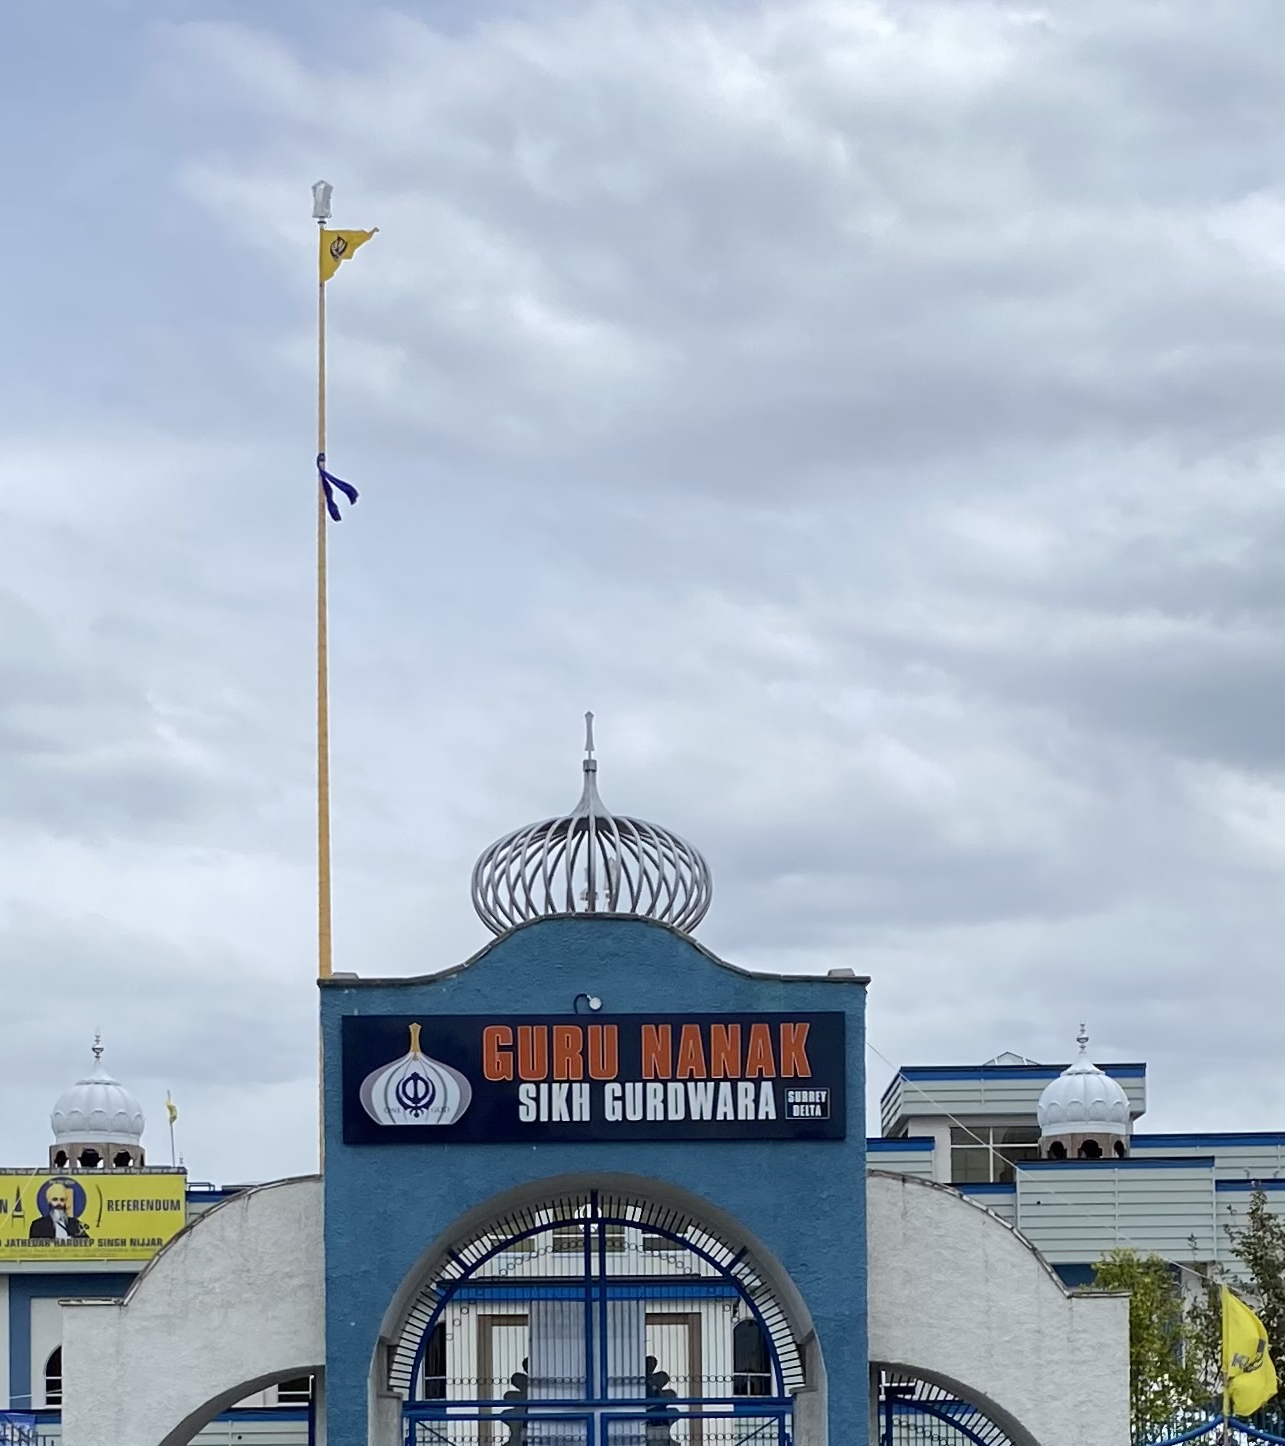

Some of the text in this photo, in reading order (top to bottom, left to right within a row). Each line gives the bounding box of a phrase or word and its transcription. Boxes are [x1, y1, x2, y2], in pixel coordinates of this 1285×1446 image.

[483, 1023, 812, 1081] GURU NANAK
[518, 1081, 777, 1122] SIKH GURDWARA
[788, 1090, 827, 1103] SURREY
[793, 1104, 822, 1117] DELTA
[107, 1198, 181, 1212] REFERENDUM
[98, 1238, 127, 1247] SINGH
[130, 1238, 163, 1247] NIJJAR
